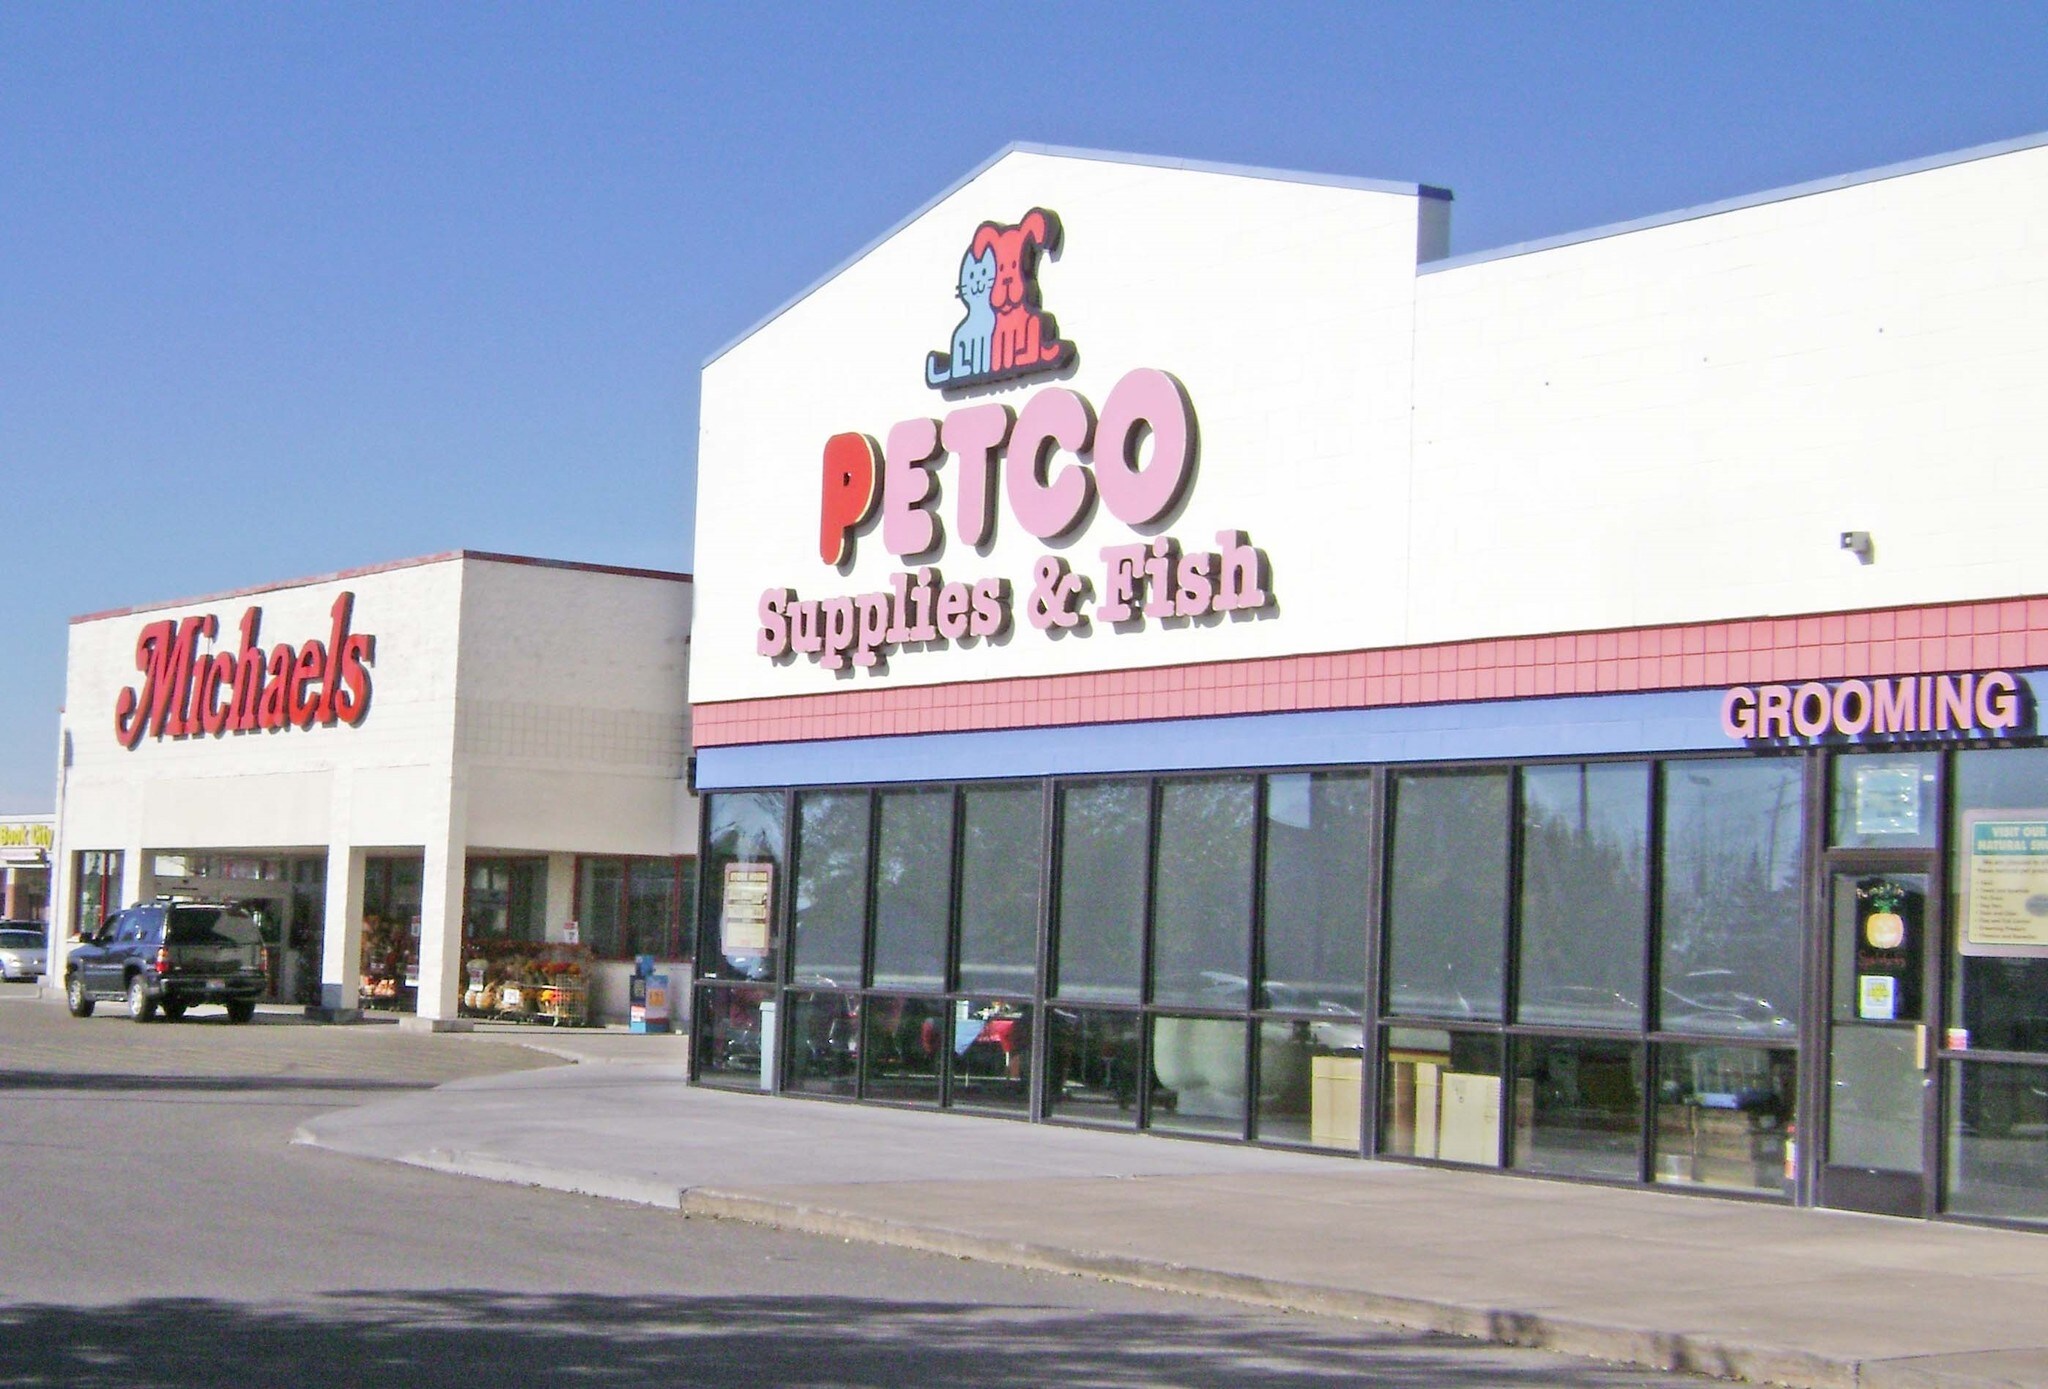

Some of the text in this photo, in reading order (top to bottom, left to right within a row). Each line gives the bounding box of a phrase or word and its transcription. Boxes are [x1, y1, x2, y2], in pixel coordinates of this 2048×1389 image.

[820, 367, 1194, 568] PETCO
[115, 590, 375, 750] Michaels
[757, 529, 1268, 670] Supplies & Fish
[1721, 671, 2019, 739] GROOMING
[31, 824, 53, 850] City
